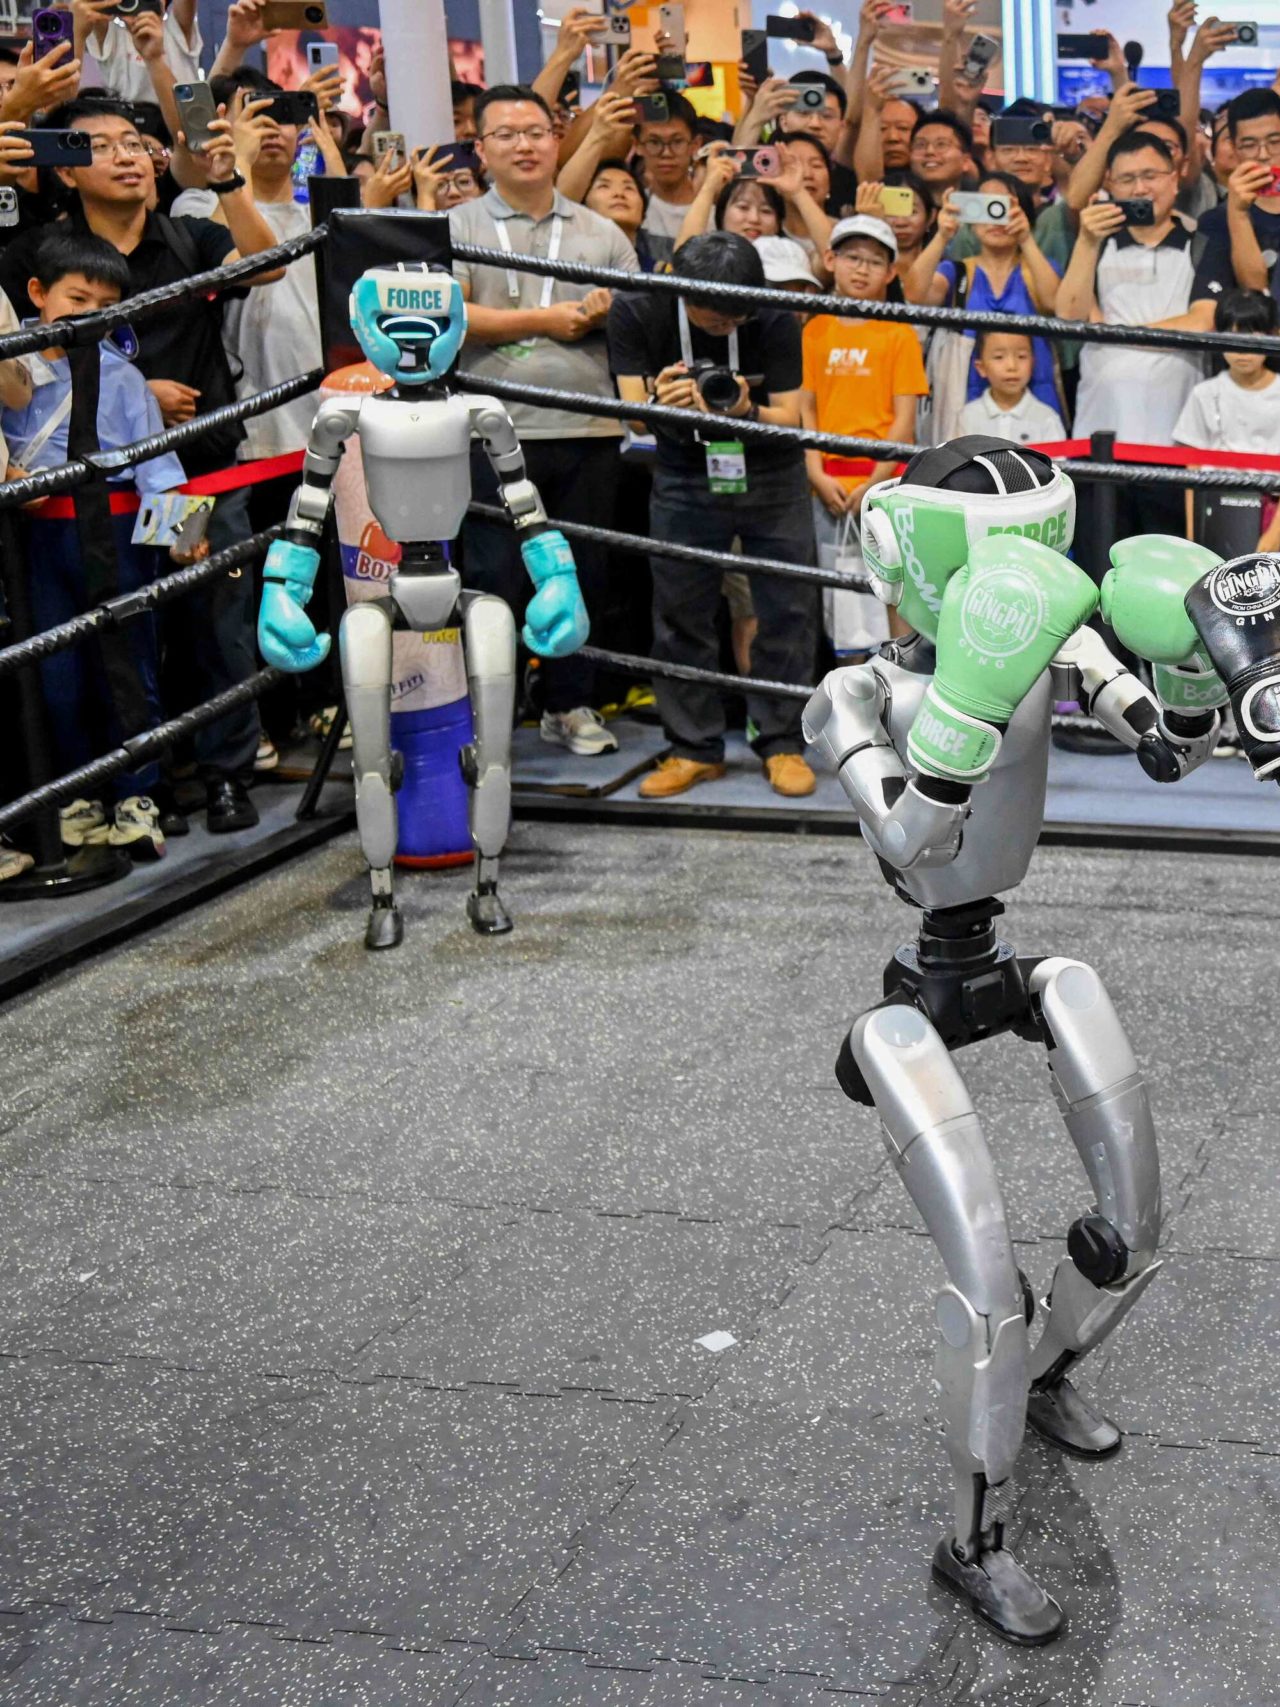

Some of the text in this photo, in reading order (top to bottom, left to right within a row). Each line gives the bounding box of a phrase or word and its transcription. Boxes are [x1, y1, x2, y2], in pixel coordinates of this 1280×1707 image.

[386, 287, 443, 310] FORCE
[967, 587, 1034, 642] GINGPAI
[958, 638, 1006, 670] GING
